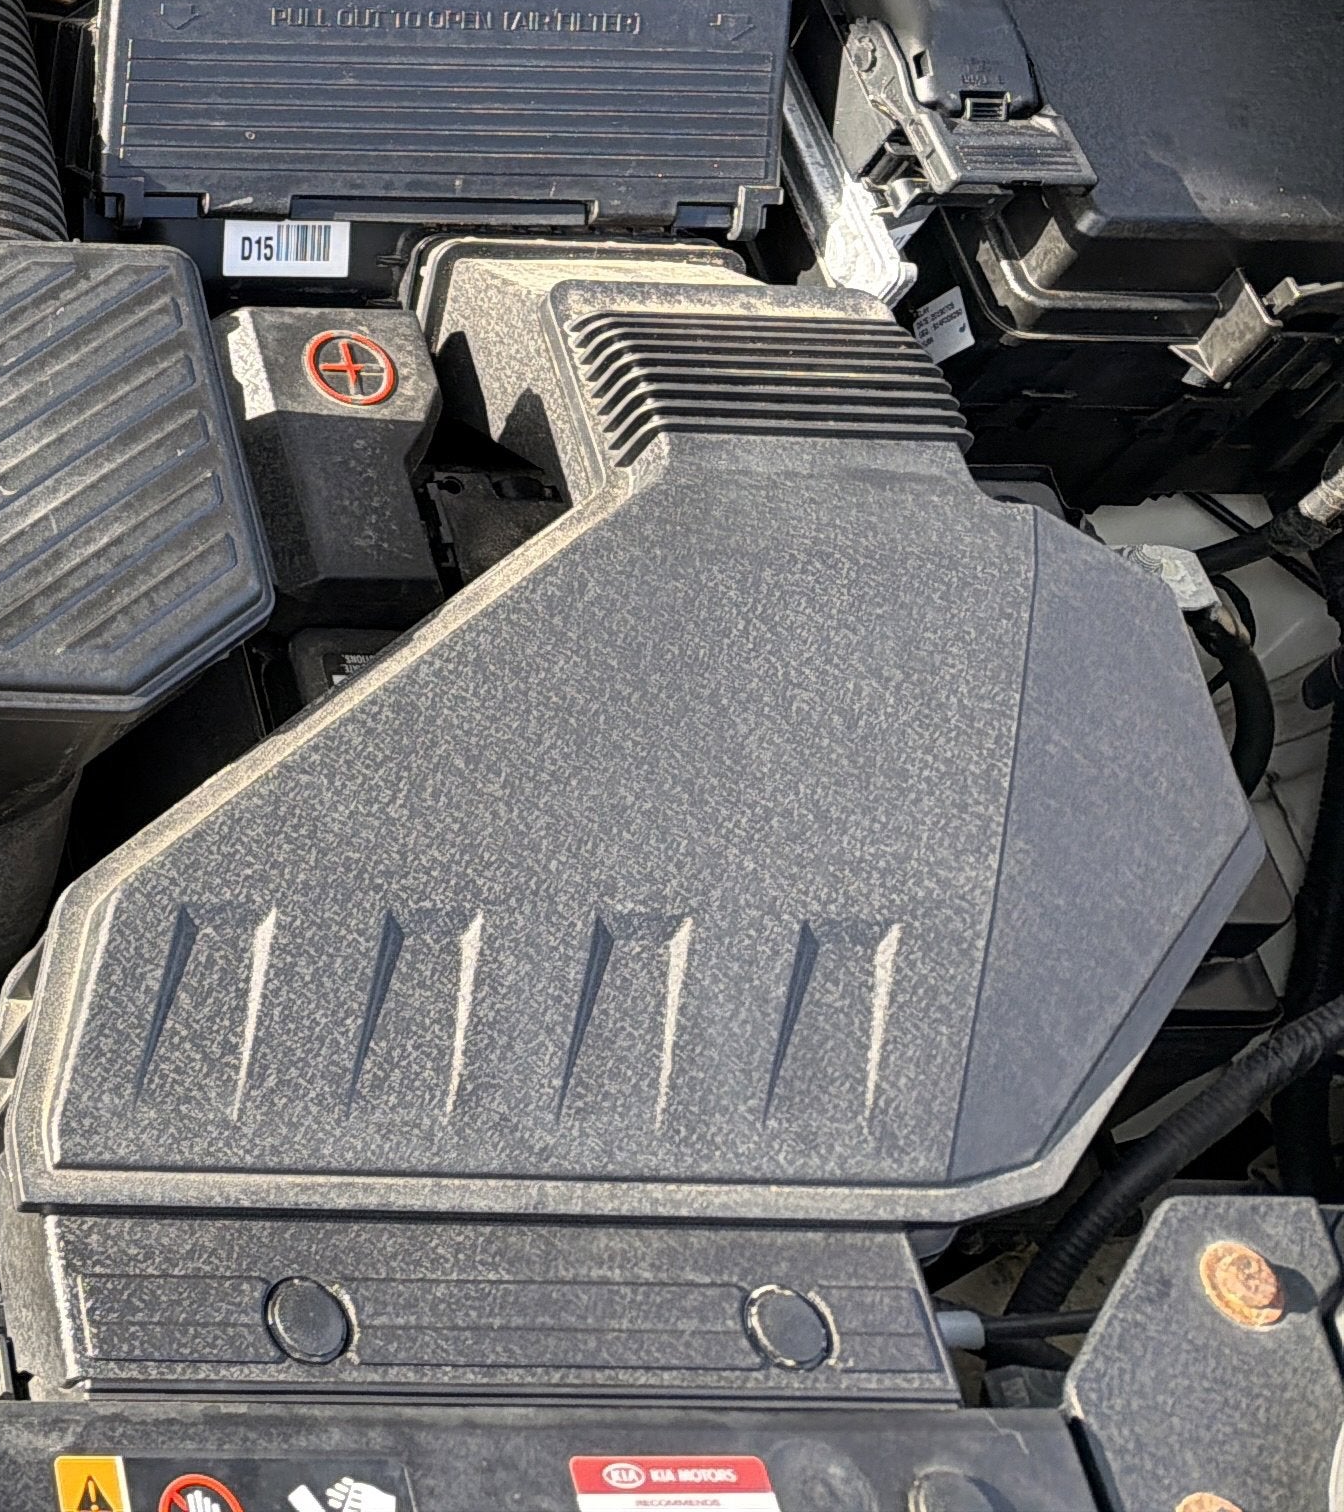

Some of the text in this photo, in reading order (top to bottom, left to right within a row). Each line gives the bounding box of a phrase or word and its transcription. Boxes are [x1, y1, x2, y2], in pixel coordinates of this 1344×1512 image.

[271, 7, 330, 27] PULL
[337, 7, 388, 28] OUT
[391, 9, 423, 28] TO
[428, 9, 492, 29] OPEN
[241, 236, 274, 261] D15
[649, 1469, 677, 1482] KIA
[679, 1469, 737, 1483] MOTORS
